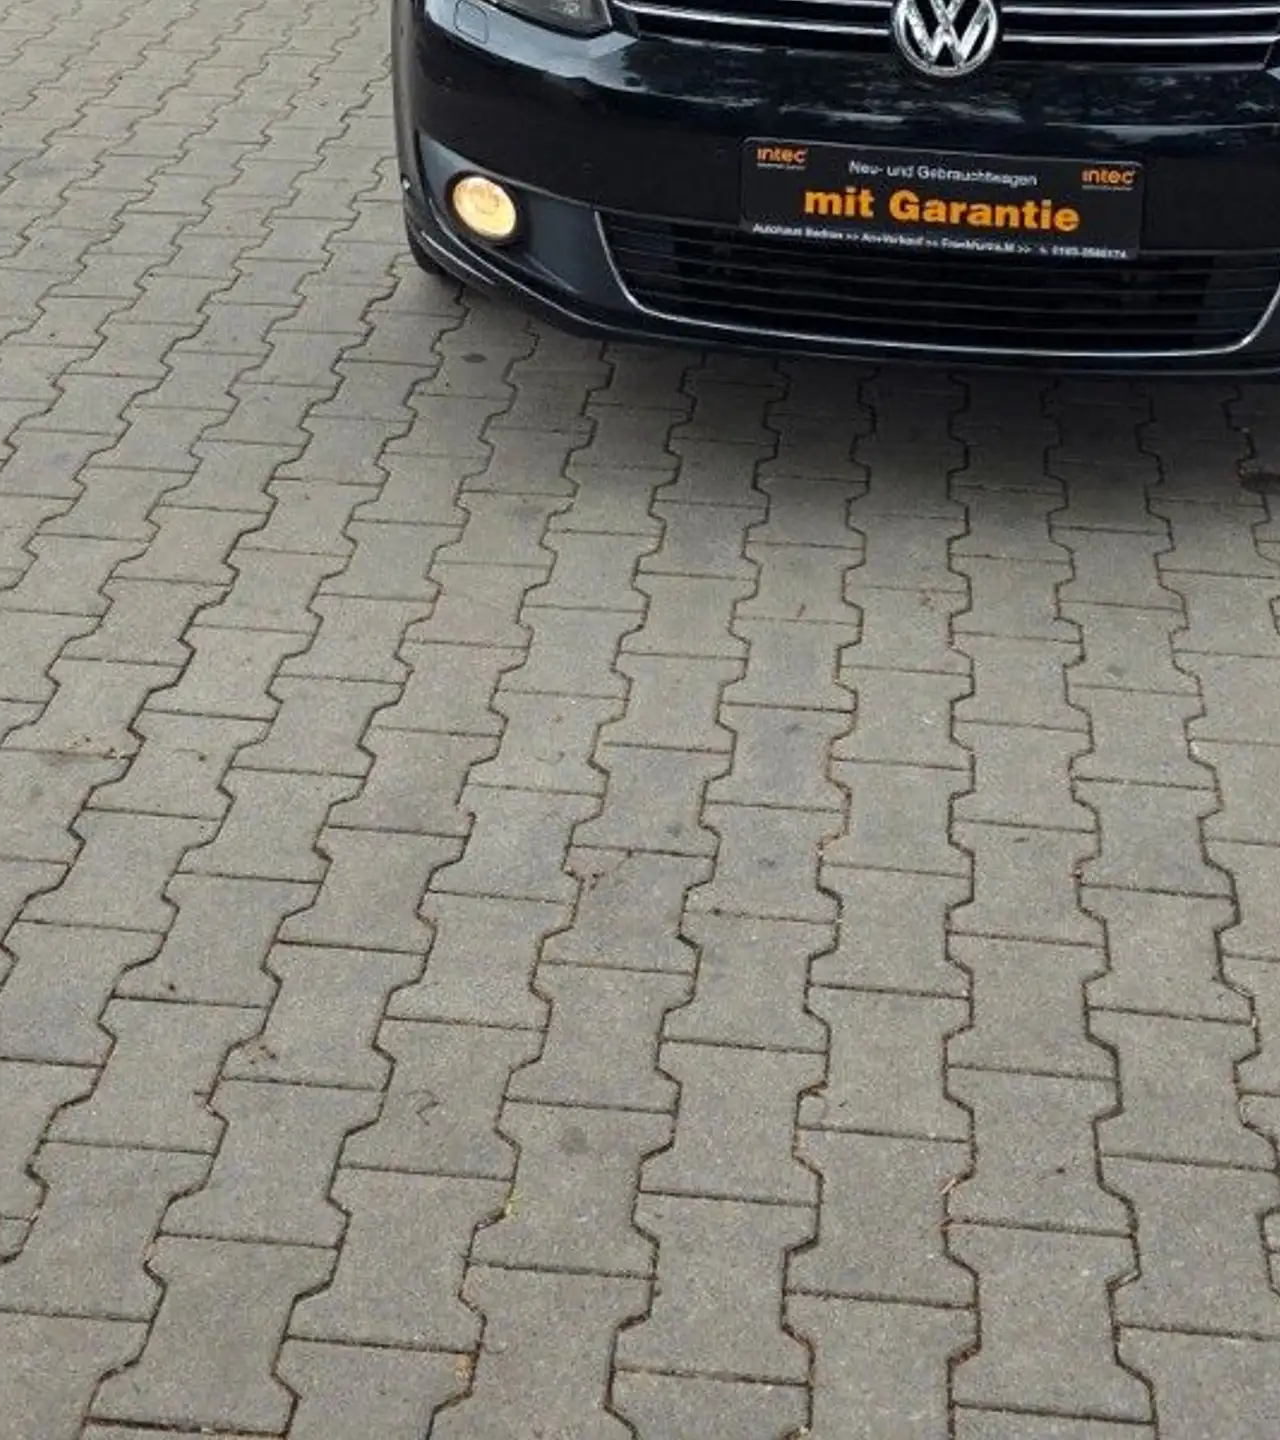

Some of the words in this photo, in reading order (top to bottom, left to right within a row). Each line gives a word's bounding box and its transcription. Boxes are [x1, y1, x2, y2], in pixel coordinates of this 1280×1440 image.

[886, 164, 913, 178] und
[916, 165, 1038, 188] Gebrauchtwagen
[803, 185, 875, 219] mit
[888, 189, 1081, 233] Garantie
